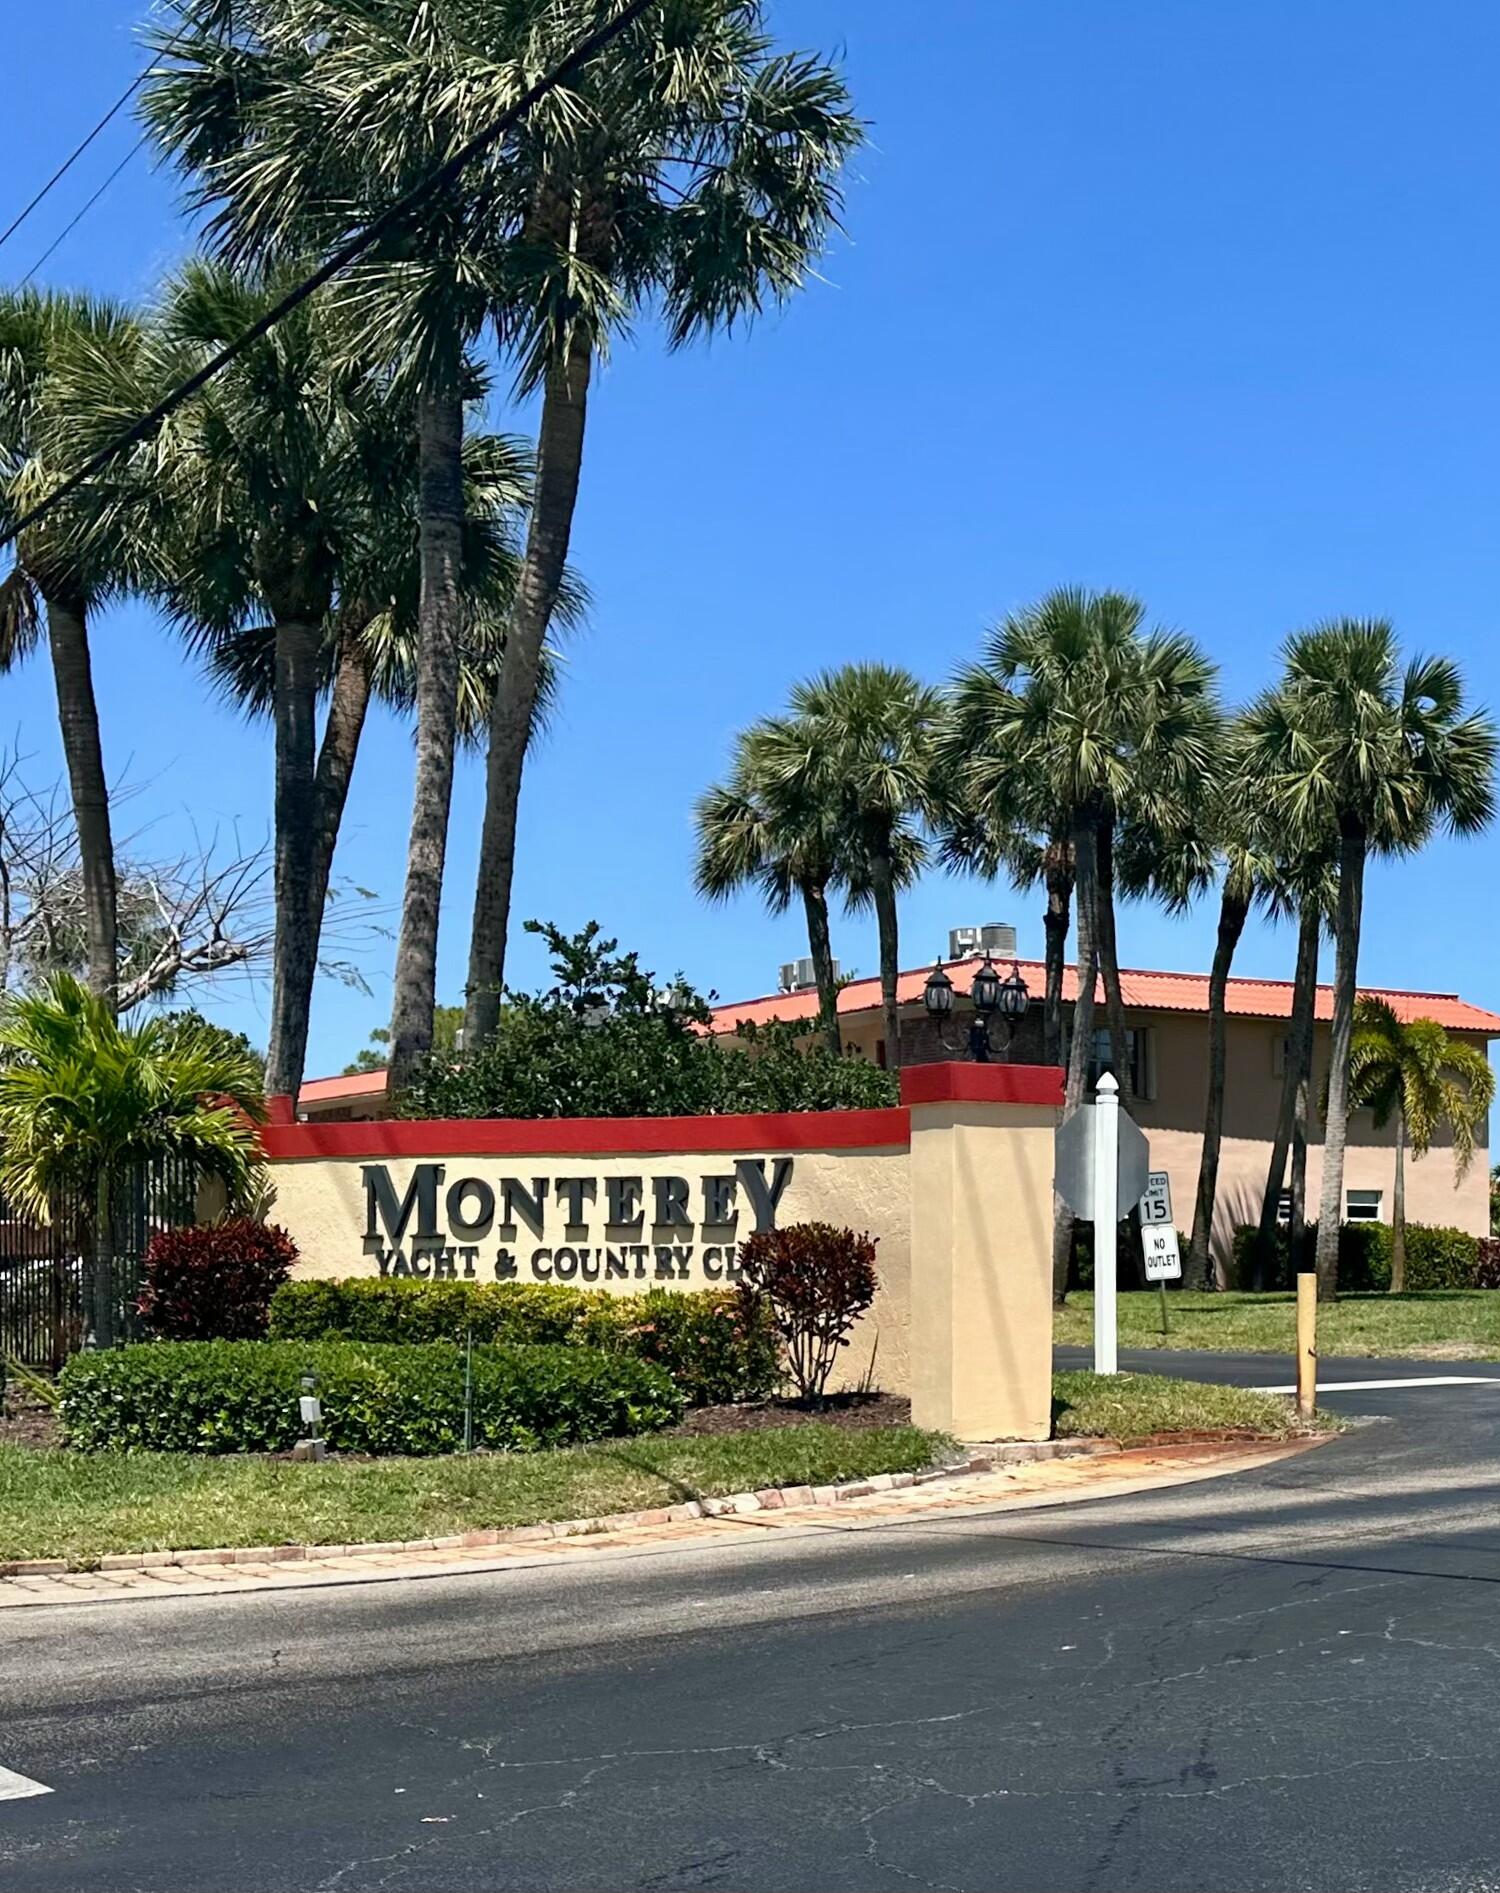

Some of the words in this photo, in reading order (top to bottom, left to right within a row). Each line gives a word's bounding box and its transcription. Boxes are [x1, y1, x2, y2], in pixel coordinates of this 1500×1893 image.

[1150, 1177, 1166, 1186] EED
[359, 1157, 794, 1242] MONTEREY
[1144, 1200, 1166, 1219] 15
[1154, 1238, 1165, 1250] NO
[375, 1246, 479, 1280] YACHT
[495, 1248, 518, 1280] &
[532, 1246, 694, 1281] COUNTRY
[703, 1246, 743, 1281] CL
[1147, 1254, 1176, 1268] OUTLET
